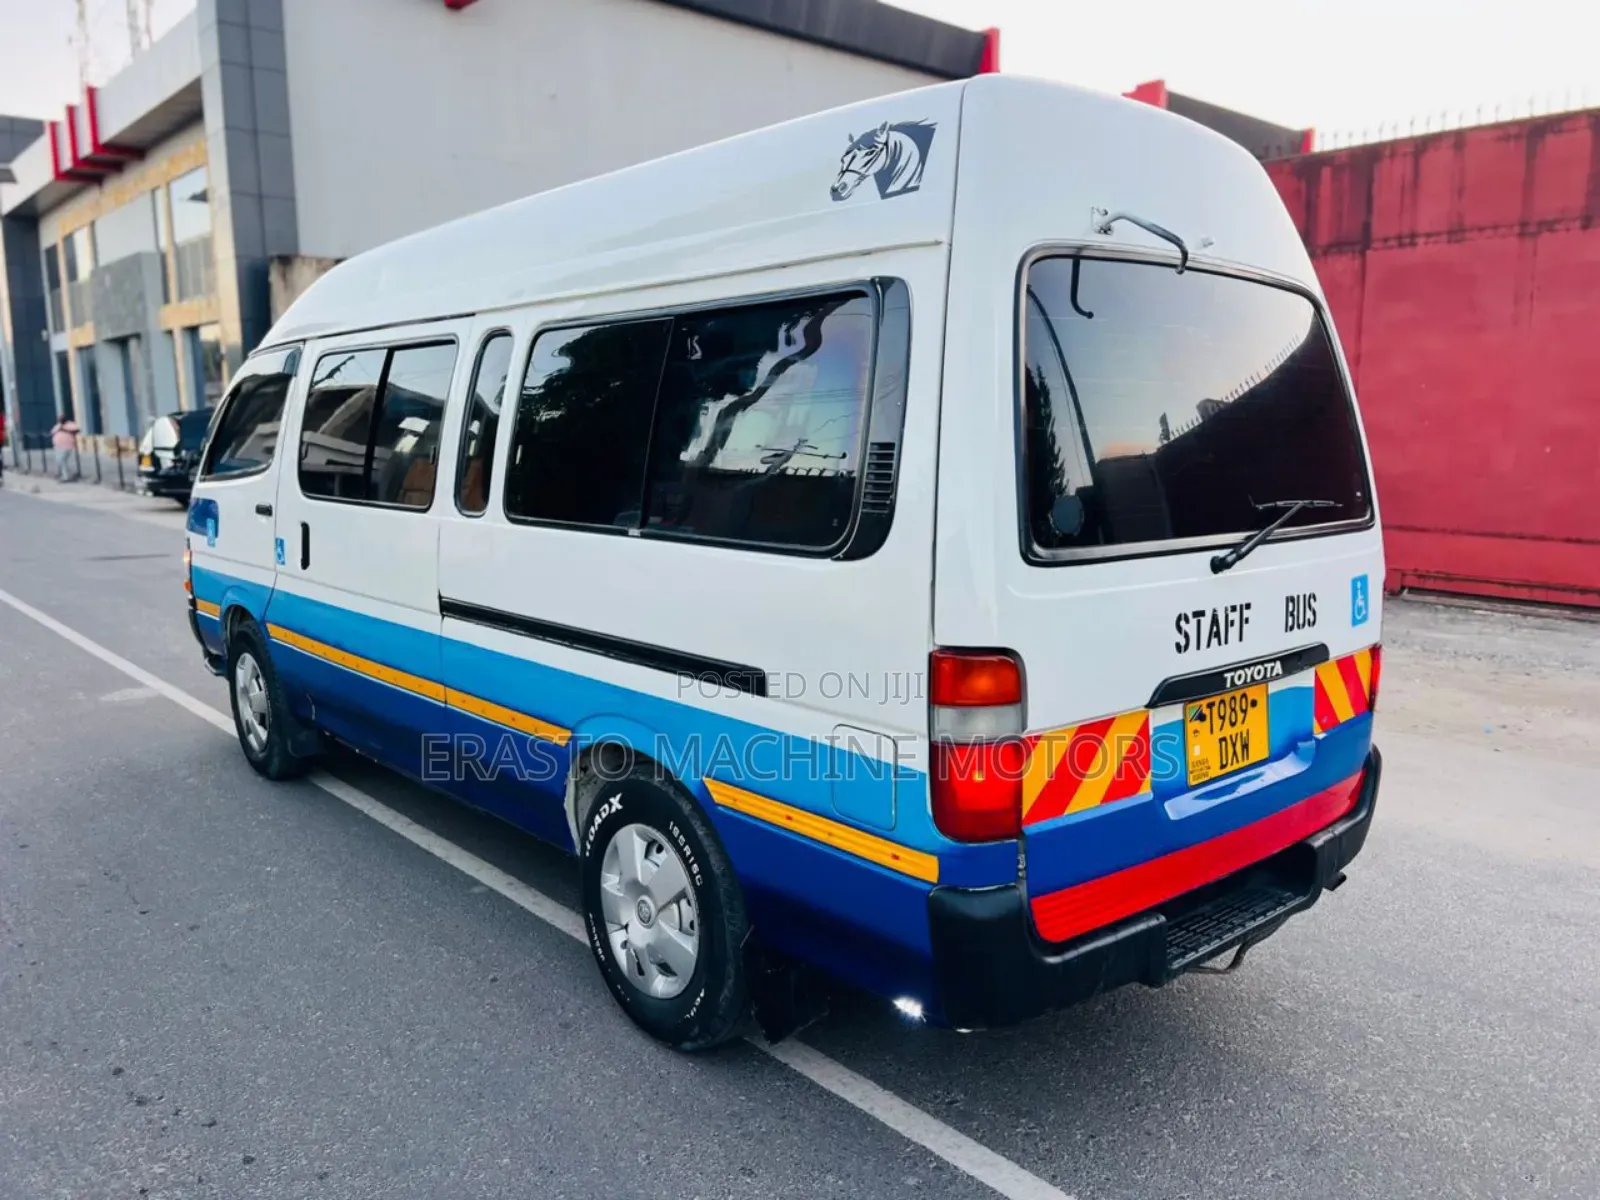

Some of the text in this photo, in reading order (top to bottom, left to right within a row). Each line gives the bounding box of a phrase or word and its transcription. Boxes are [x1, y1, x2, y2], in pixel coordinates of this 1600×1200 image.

[1174, 592, 1317, 654] STAFF BUS
[1224, 660, 1283, 688] TOYOTA
[1206, 692, 1249, 735] T989
[1218, 728, 1250, 770] DXW
